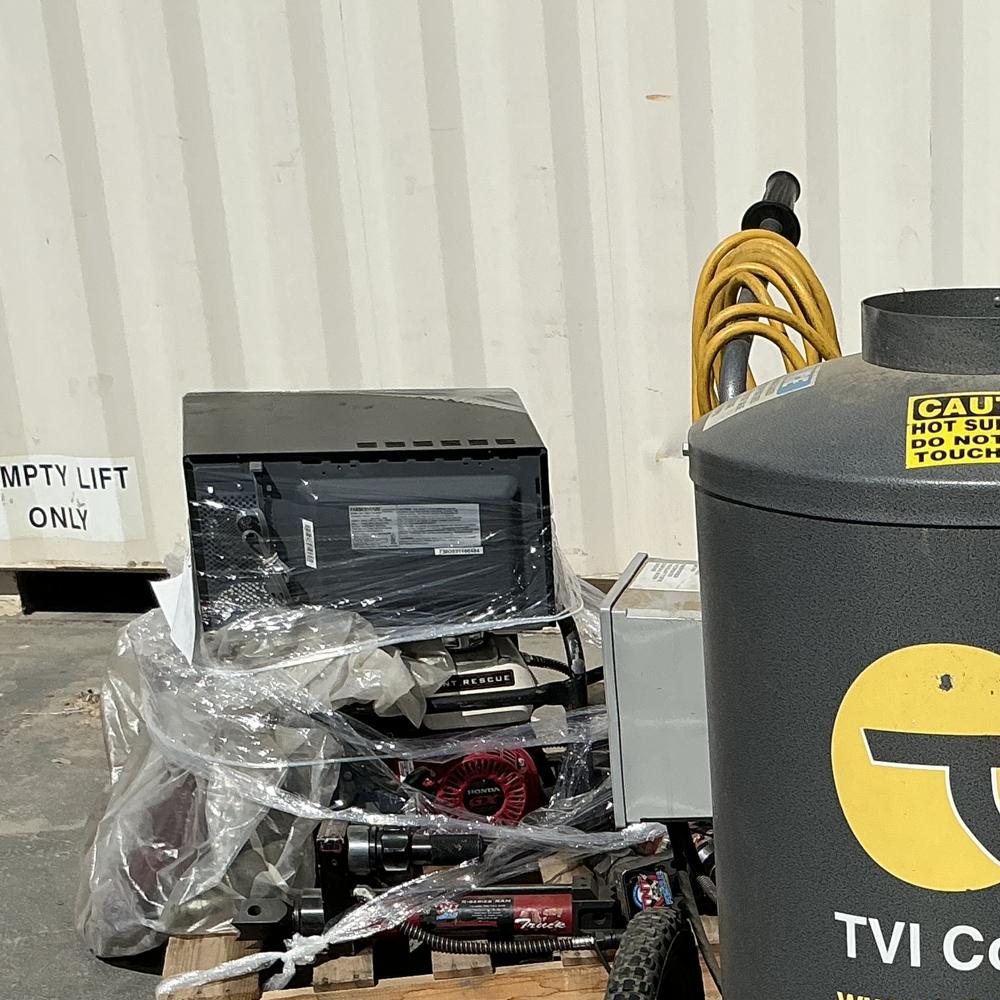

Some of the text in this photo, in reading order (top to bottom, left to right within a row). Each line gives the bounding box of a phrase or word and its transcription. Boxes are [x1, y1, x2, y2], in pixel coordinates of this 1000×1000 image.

[911, 420, 956, 435] HOT
[911, 437, 945, 449] DO
[77, 466, 128, 489] LIFT
[29, 507, 88, 531] ONLY
[462, 674, 511, 686] RESCUE
[467, 786, 501, 796] HONDA
[834, 911, 921, 967] TVI
